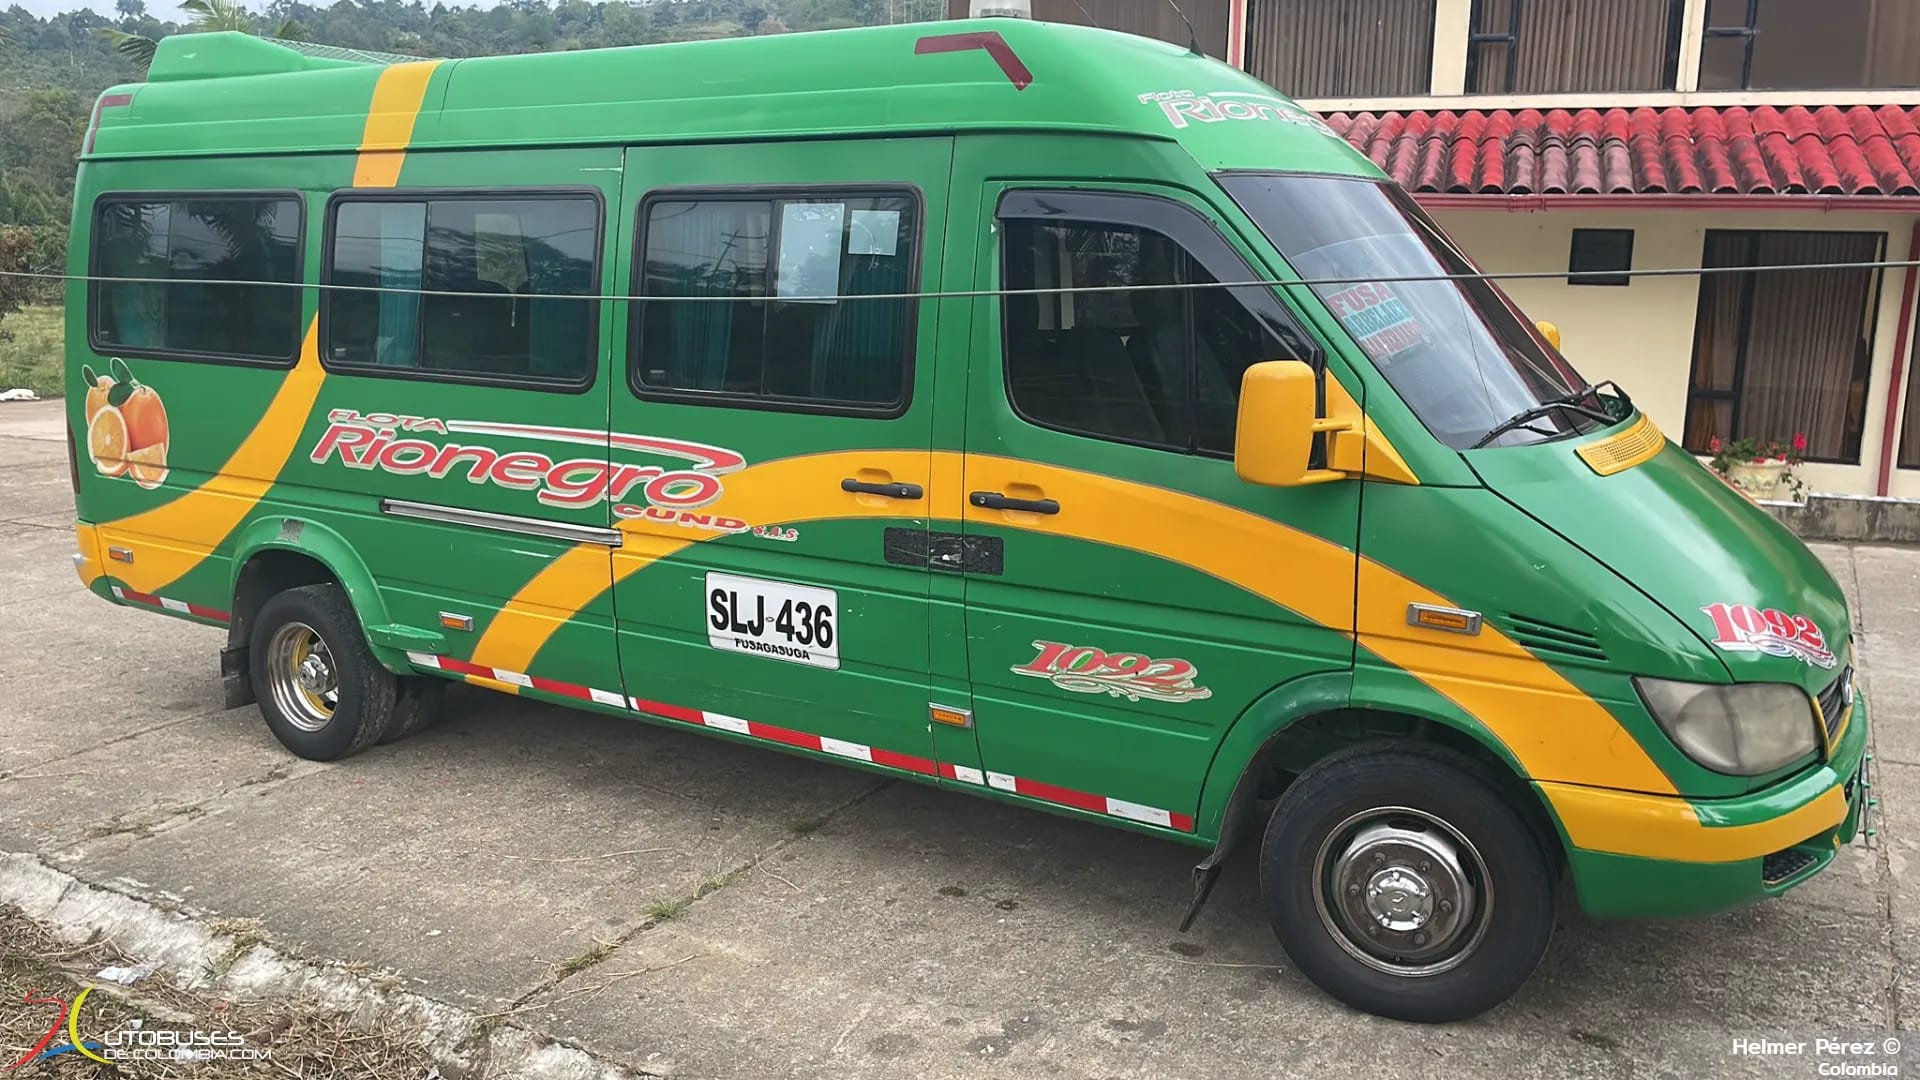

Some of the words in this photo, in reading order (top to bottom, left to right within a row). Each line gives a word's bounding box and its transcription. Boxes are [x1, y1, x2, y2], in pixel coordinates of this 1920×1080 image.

[1137, 89, 1194, 104] Flota
[328, 409, 449, 434] FLOTA
[310, 422, 724, 510] Rionegro
[611, 502, 751, 534] CUND
[1699, 602, 1826, 652] 1092
[734, 637, 811, 661] FUSAGASUGA
[1010, 639, 1213, 694] 1092
